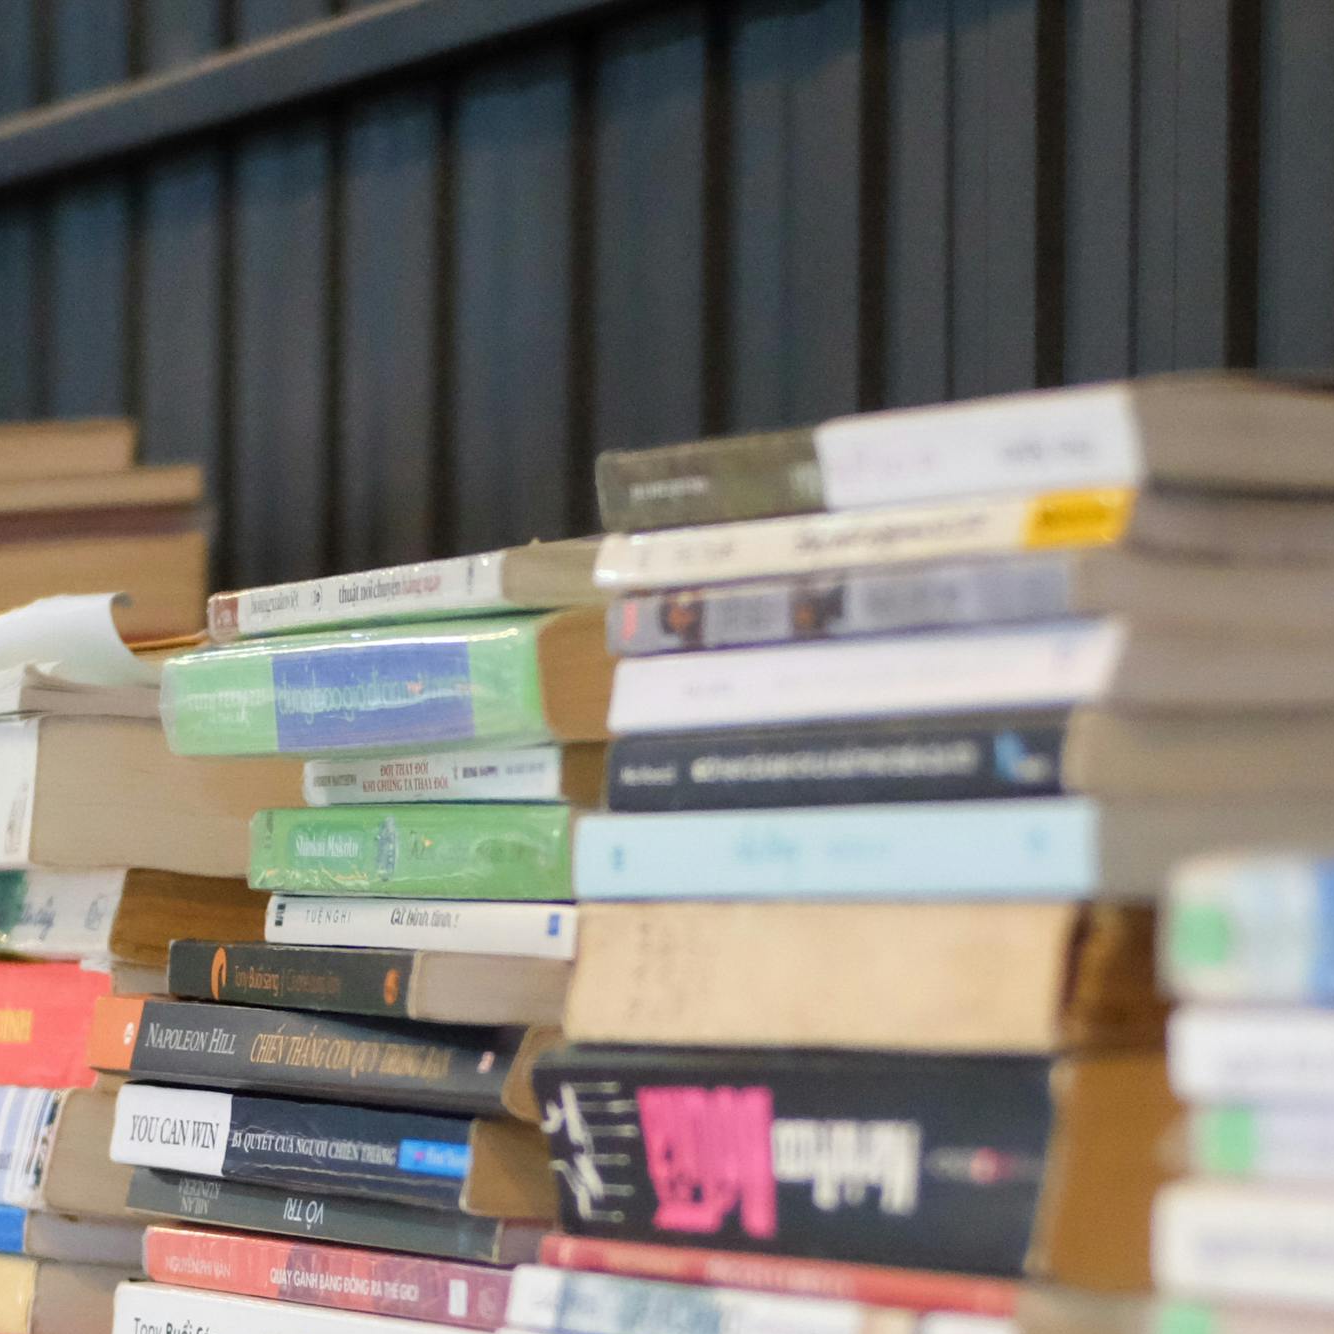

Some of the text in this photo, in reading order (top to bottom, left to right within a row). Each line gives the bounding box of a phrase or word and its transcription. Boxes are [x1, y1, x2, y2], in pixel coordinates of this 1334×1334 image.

[144, 1022, 237, 1055] NAPOLEON HILL
[130, 1115, 219, 1150] YOU CAN WIN
[282, 1197, 324, 1230] VÔ TRI
